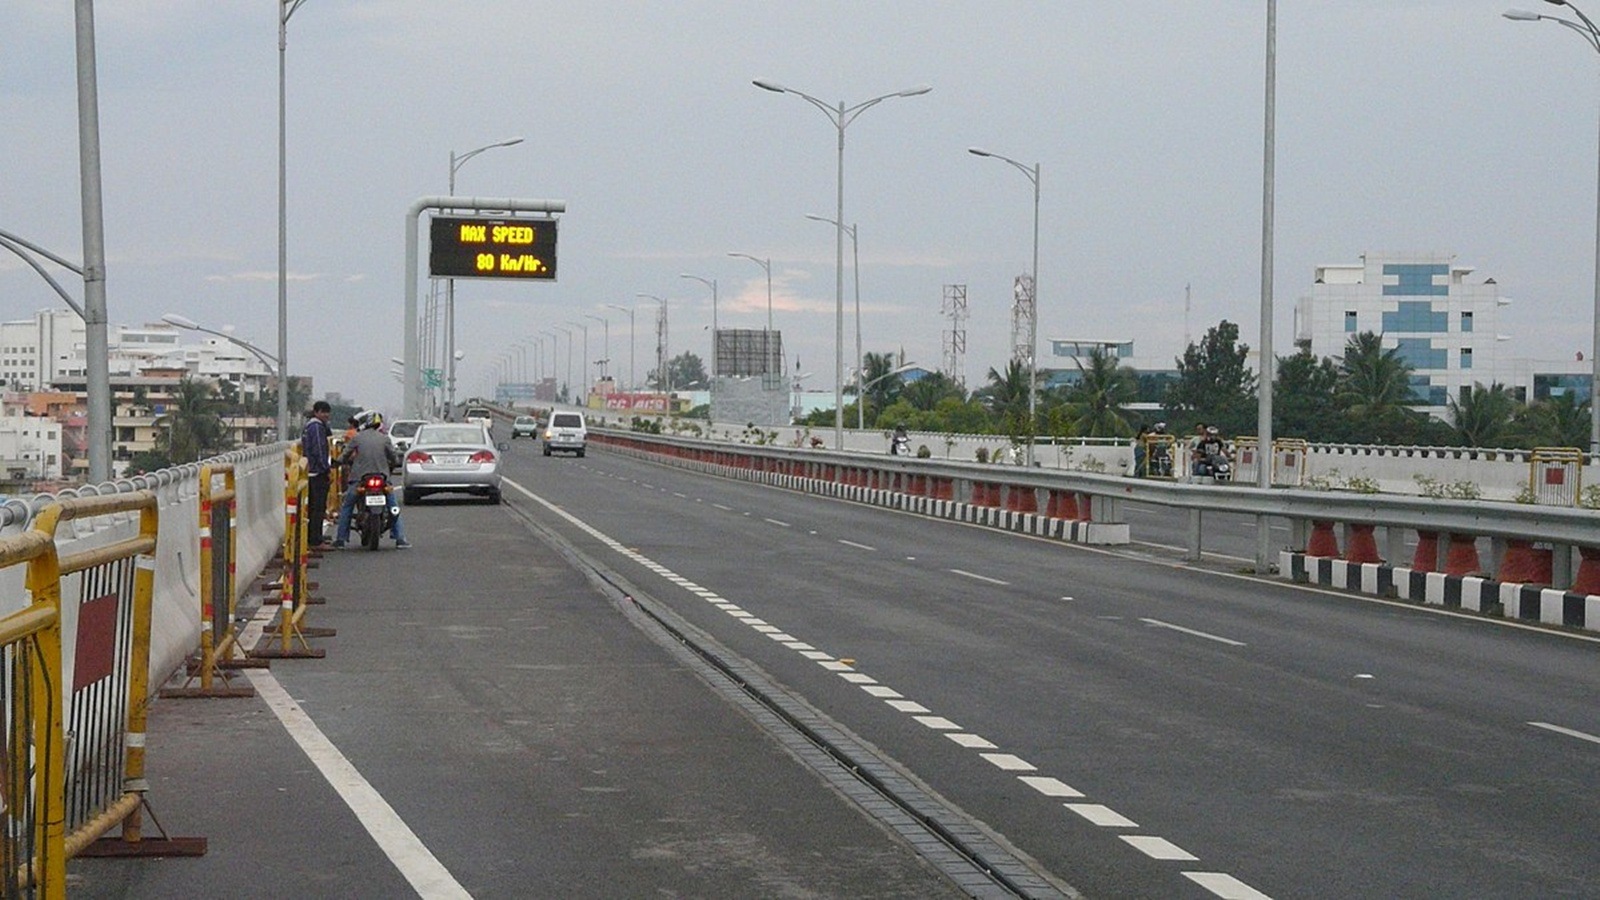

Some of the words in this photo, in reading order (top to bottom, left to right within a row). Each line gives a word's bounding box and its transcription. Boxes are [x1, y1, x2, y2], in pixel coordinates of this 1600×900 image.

[460, 225, 486, 242] MAX
[492, 226, 534, 244] SPEED
[476, 253, 495, 271] 80
